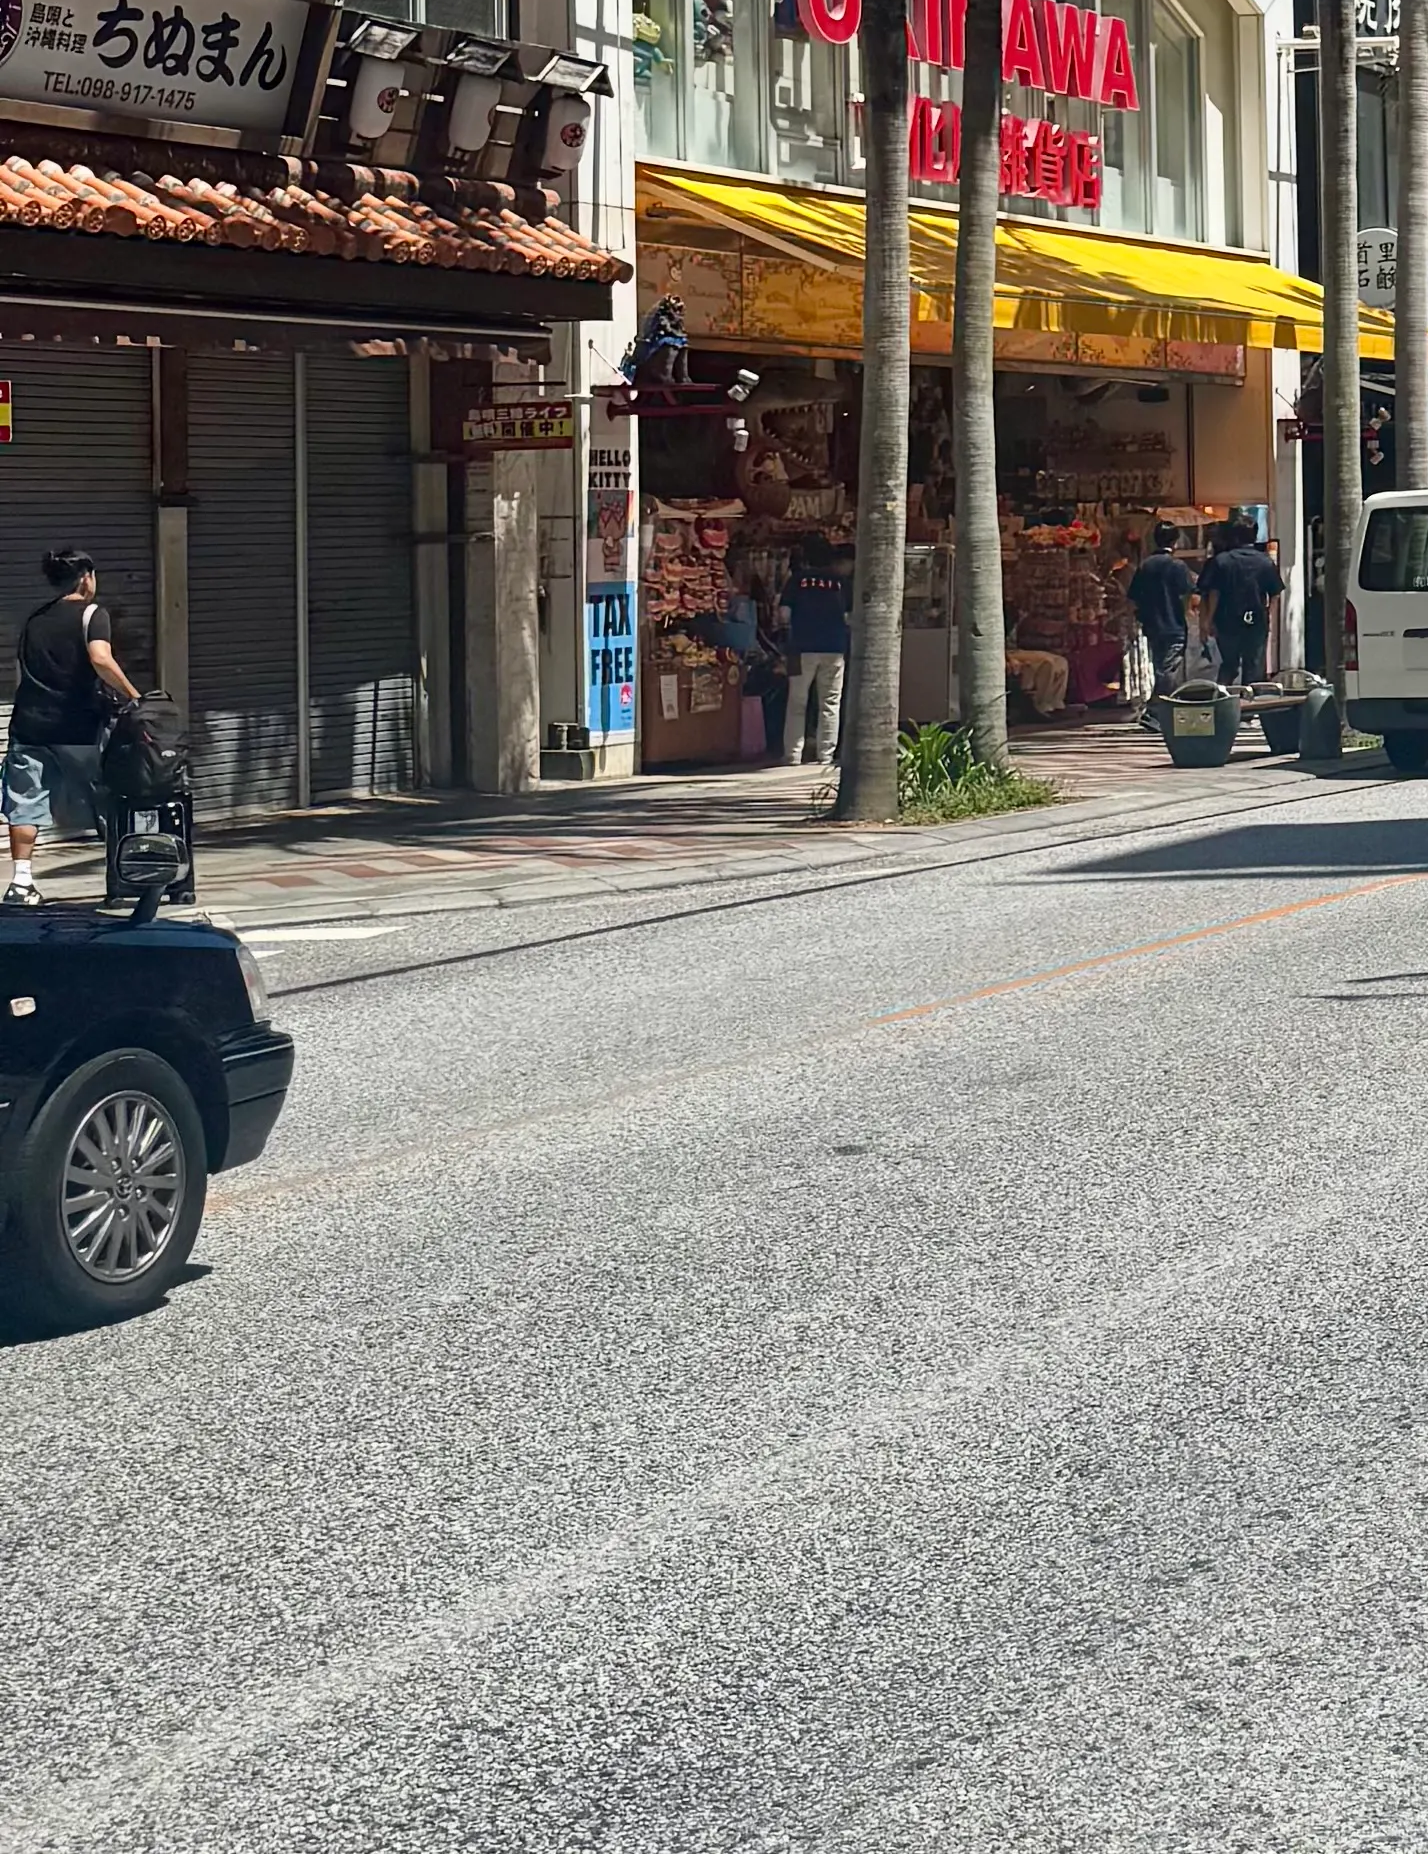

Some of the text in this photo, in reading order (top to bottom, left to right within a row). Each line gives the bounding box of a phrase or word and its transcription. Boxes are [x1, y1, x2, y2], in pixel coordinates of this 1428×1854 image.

[24, 26, 88, 55] 沖縄料理
[43, 70, 197, 111] TEL:098-917-1475
[588, 449, 632, 468] HELLO
[588, 471, 632, 489] KITTY
[588, 593, 632, 639] TAX
[590, 645, 634, 686] FREE
